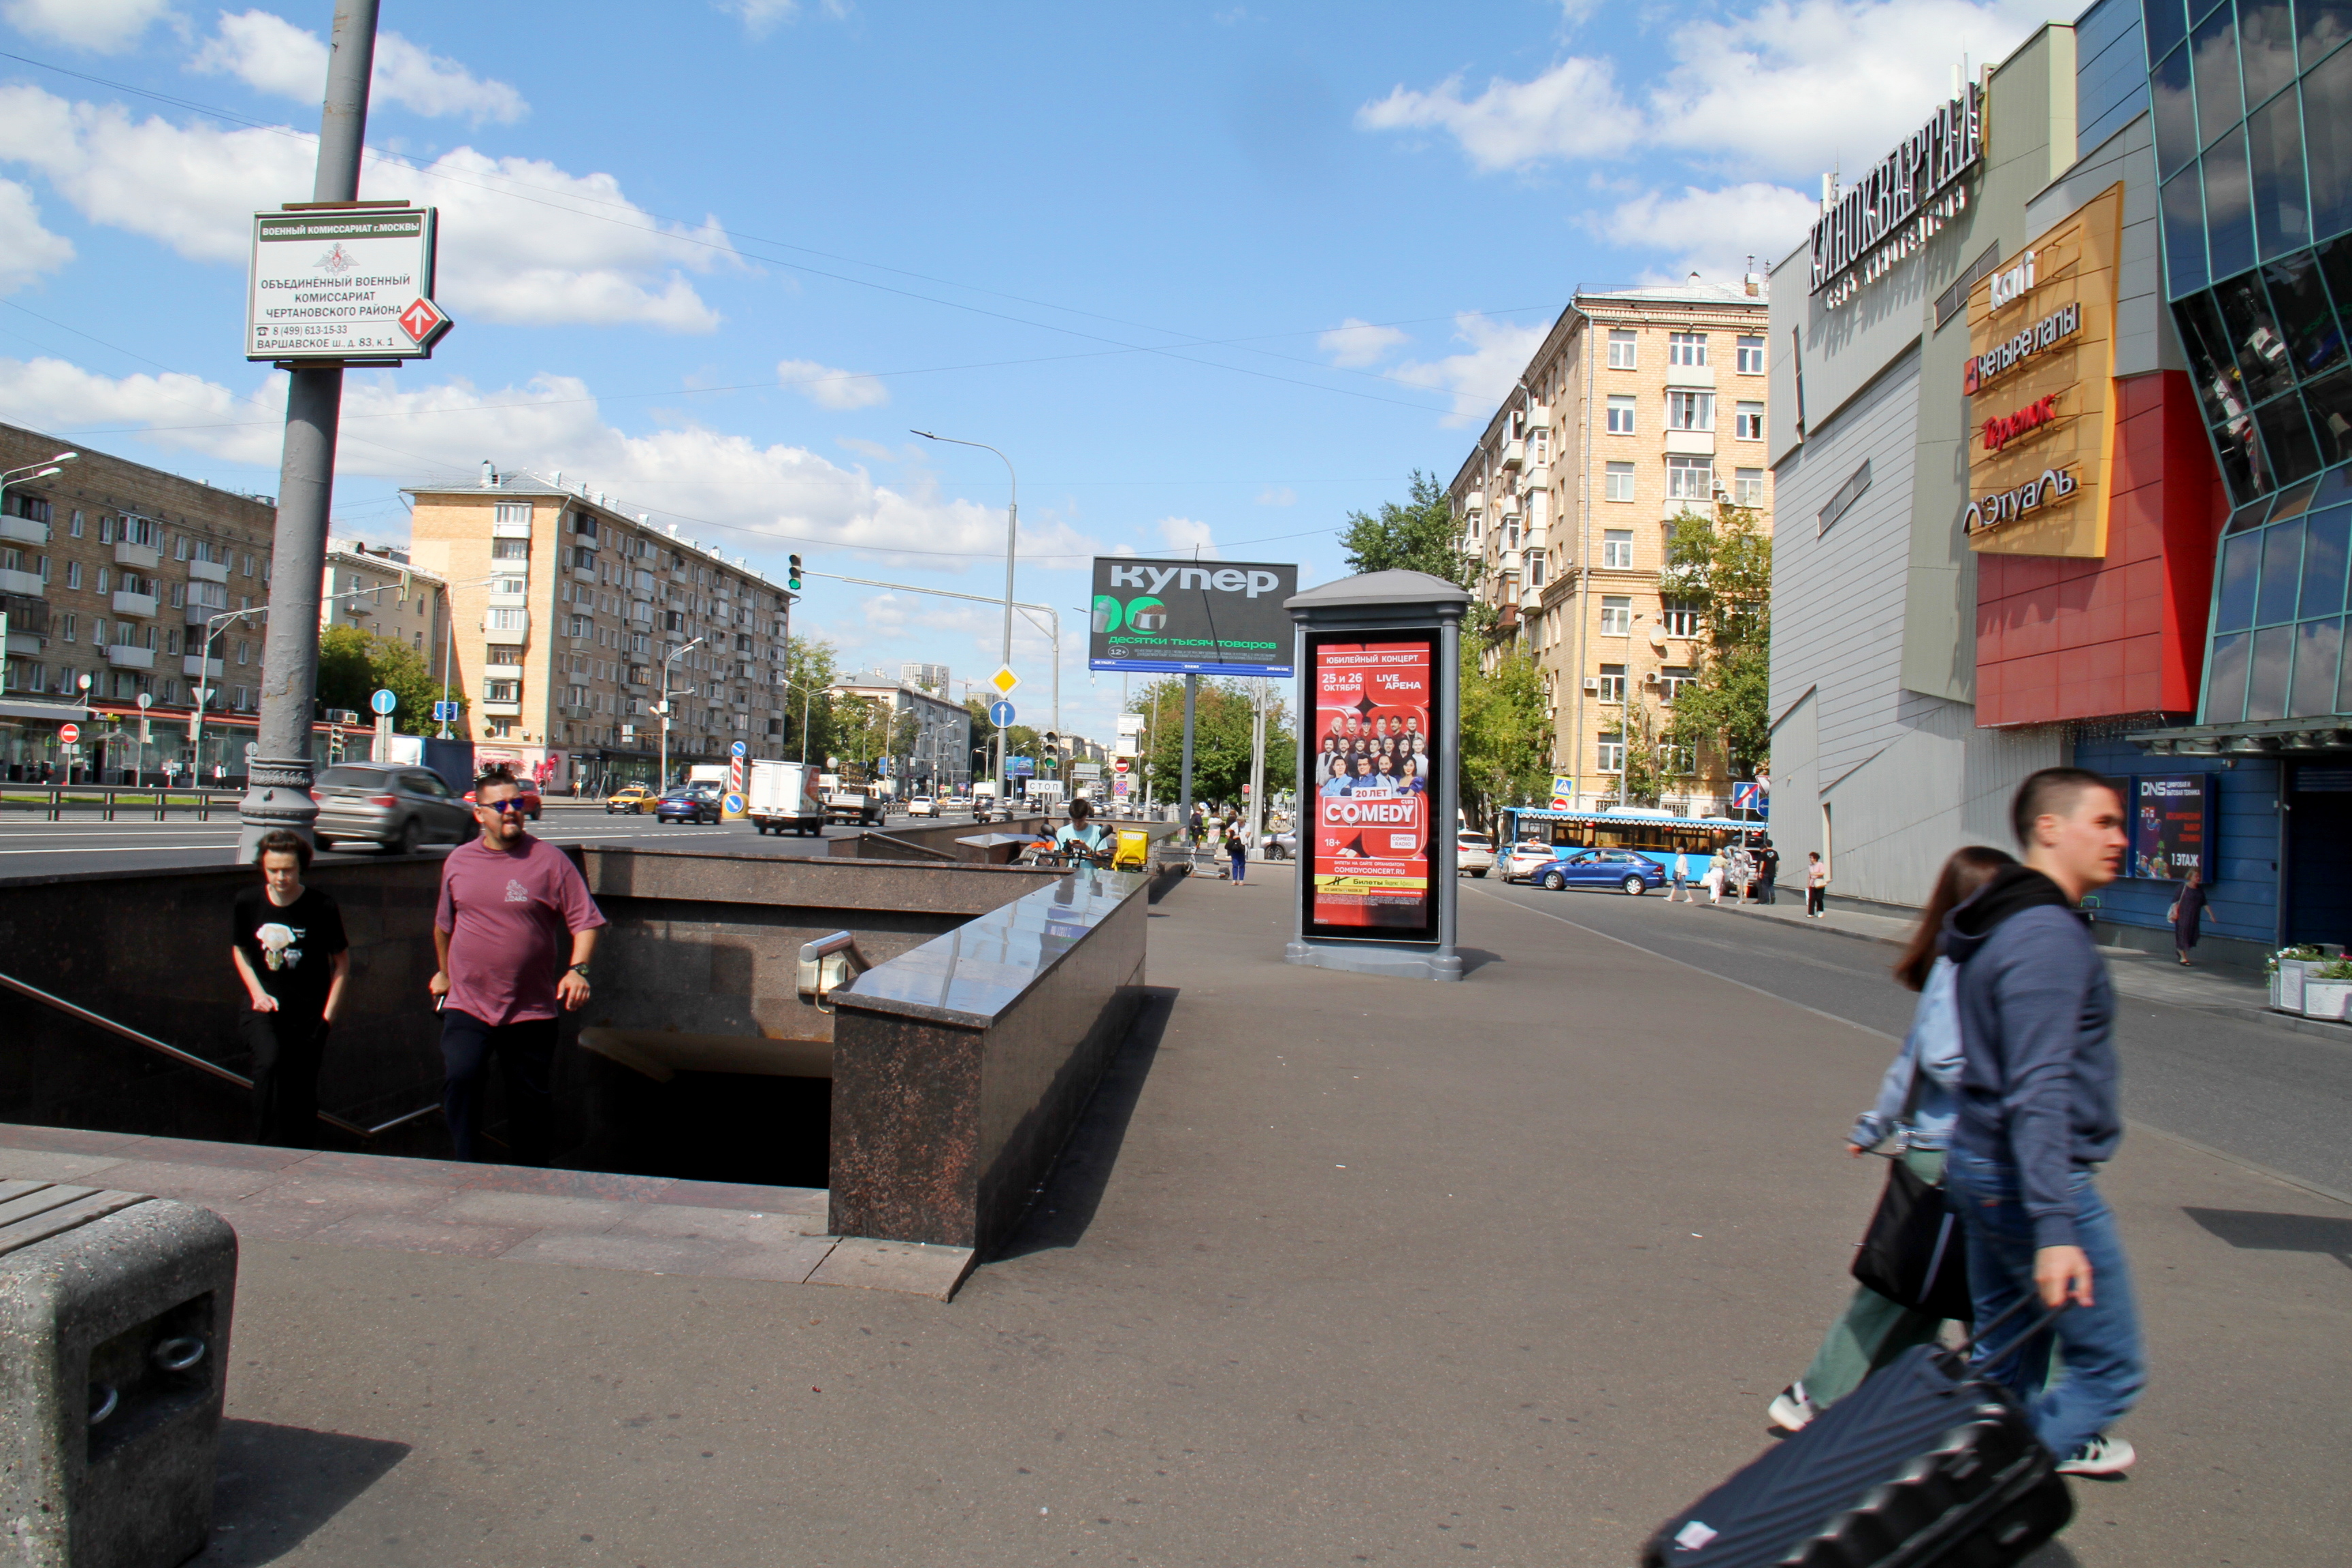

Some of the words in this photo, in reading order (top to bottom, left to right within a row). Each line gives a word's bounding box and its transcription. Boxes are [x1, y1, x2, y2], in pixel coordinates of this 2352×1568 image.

[263, 225, 306, 236] ВОЕННЫЙ
[308, 225, 372, 234] КОМИССАРИАТ
[374, 223, 419, 232] г.МОСКВЫ
[261, 276, 351, 290] ОБЪЕДИНЁННЫЙ
[355, 274, 410, 287] ВОЕННЫЙ
[1991, 250, 2035, 311] kari
[295, 292, 376, 303] КОМИССАРИАТ
[266, 306, 356, 318] ЧЕРТАНОВСКОГО
[359, 304, 402, 316] РАЙОНА
[273, 327, 278, 336] 8
[280, 326, 303, 337] (499)
[305, 325, 348, 335] 613-15-33
[257, 339, 329, 348] ВАРШАВСКОЕ
[387, 337, 394, 346] 1
[1978, 328, 2032, 379] четыре
[2033, 301, 2080, 352] лапы
[1111, 565, 1279, 598] купер
[1109, 636, 1168, 645] десятки
[1171, 638, 1213, 647] тысяч
[1217, 640, 1277, 650] товаров
[1326, 654, 1378, 664] ЮБИЛЕЙНЫЙ
[1382, 654, 1418, 663] КОНЦЕРТ
[1322, 673, 1336, 683] 25
[1348, 673, 1362, 683] 26
[1376, 674, 1399, 682] LIVE
[1324, 683, 1360, 691] ОКТЯБРЯ
[1385, 681, 1421, 689] АРЕНА
[1030, 782, 1058, 790] СТОП
[2141, 781, 2166, 796] DNS
[1355, 789, 1367, 798] 20
[1369, 789, 1388, 798] ЛЕТ
[1326, 803, 1414, 823] COMEDY
[1324, 838, 1341, 847] 18+
[2171, 853, 2175, 865] 1
[2176, 853, 2199, 866] ЭТАЖ
[1334, 866, 1405, 875] COMEDYCONCERT.RU
